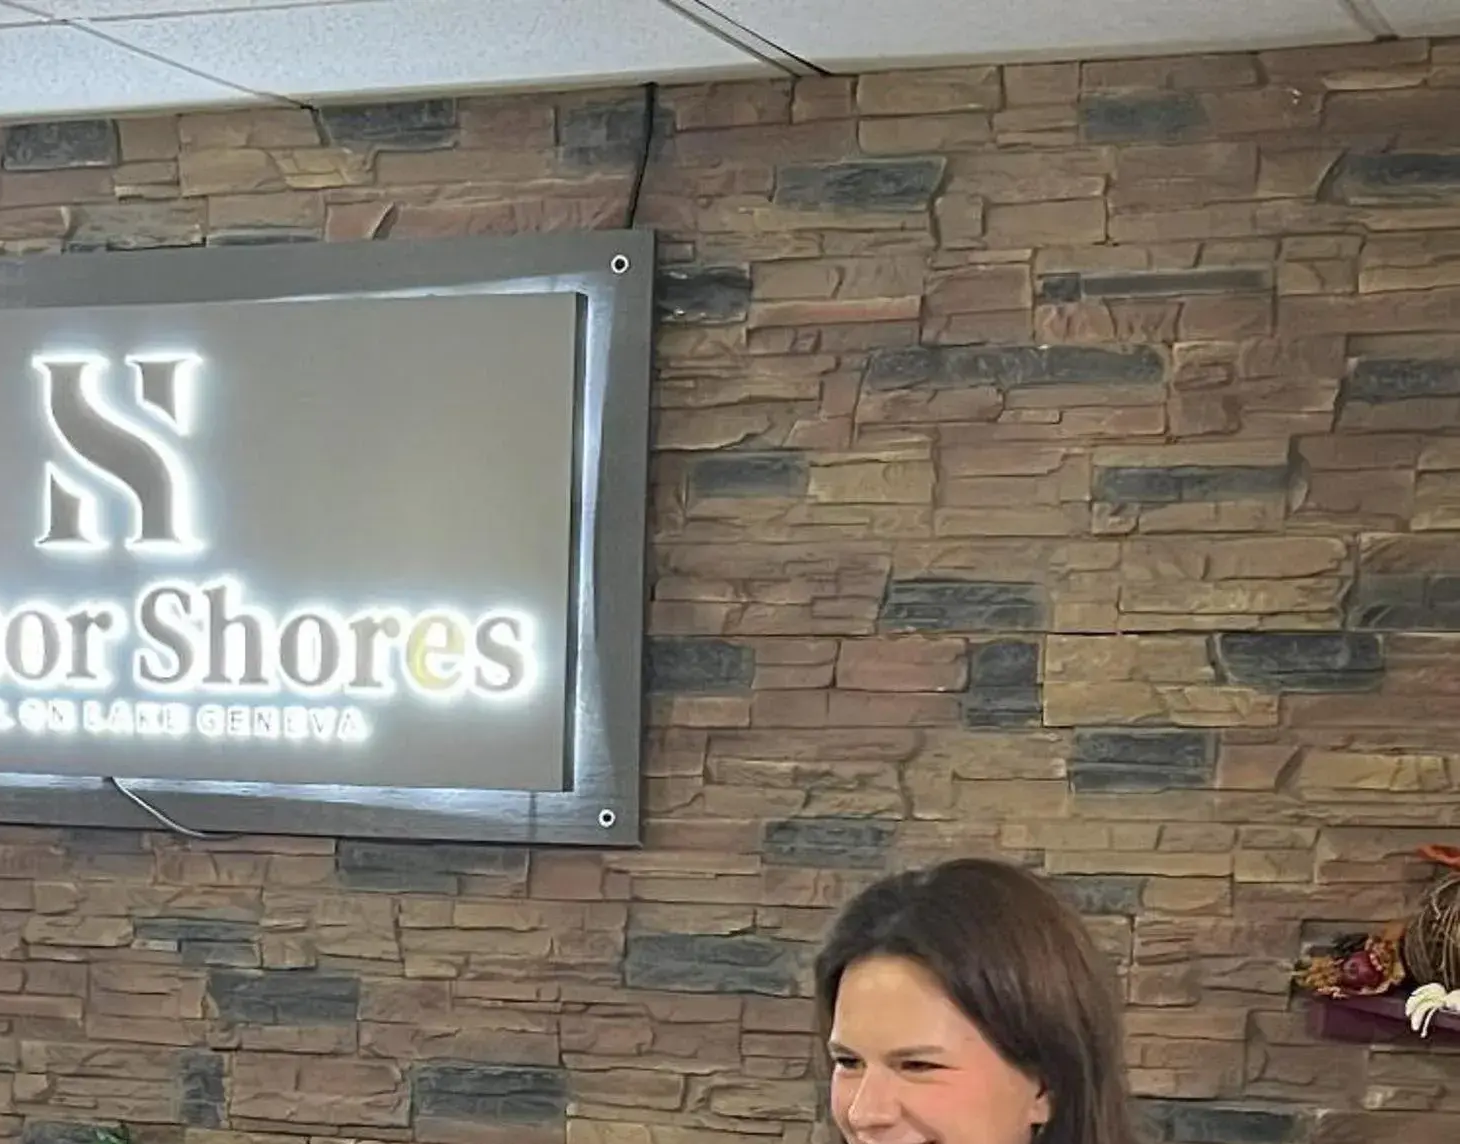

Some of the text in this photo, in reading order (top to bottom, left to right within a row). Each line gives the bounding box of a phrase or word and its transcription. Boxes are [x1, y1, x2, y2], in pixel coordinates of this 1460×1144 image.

[136, 582, 530, 694] Shores
[18, 697, 76, 732] ON
[83, 699, 190, 736] LAKE
[196, 704, 371, 741] GENEVA
